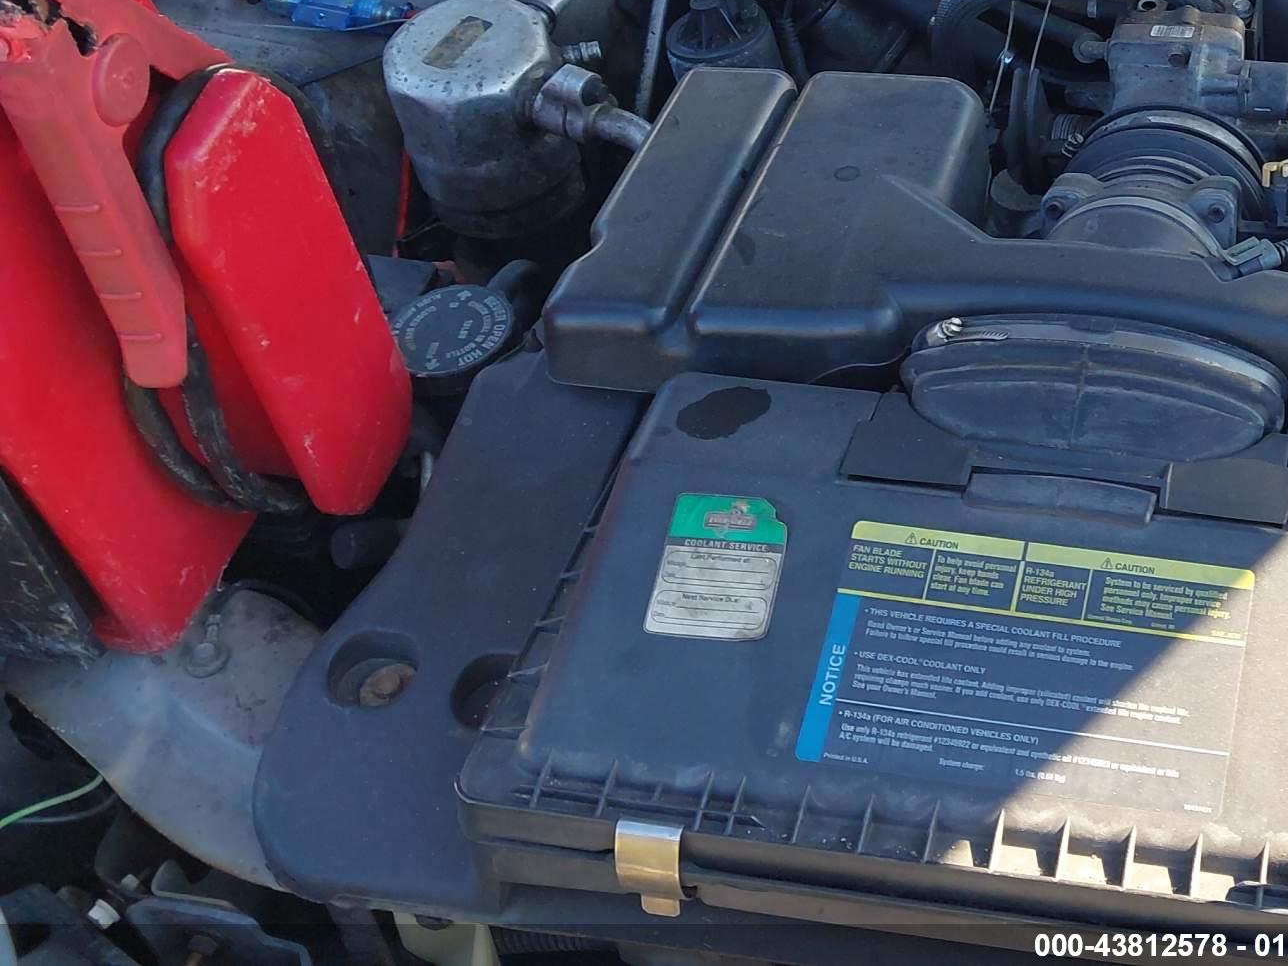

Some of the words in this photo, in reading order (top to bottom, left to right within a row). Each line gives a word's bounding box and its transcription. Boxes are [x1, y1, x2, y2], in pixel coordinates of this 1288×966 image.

[484, 296, 507, 321] NEVER
[481, 324, 506, 349] OPEN
[458, 349, 483, 366] HOT
[684, 538, 729, 550] COOLANT
[729, 541, 768, 552] SERVICE
[852, 544, 871, 553] FAN
[872, 547, 903, 557] BLADE
[918, 537, 959, 549] CAUTION
[850, 553, 886, 564] STARTS
[886, 557, 927, 569] WITHOUT
[937, 555, 946, 563] To
[946, 556, 962, 566] help
[963, 559, 984, 568] avoid
[984, 561, 1017, 573] personal
[1114, 562, 1155, 574] CAUTION
[847, 561, 883, 573] ENGINE
[883, 566, 925, 578] RUNNING
[957, 567, 976, 577] keep
[976, 570, 1000, 579] hands
[1025, 567, 1054, 577] R-134a
[930, 581, 947, 590] start
[956, 586, 970, 594] any
[953, 575, 968, 584] Fan
[968, 577, 989, 587] blade
[1023, 575, 1087, 590] REFRIGERANT
[1105, 576, 1132, 587] System
[1153, 583, 1184, 593] serviced
[1184, 587, 1193, 596] by
[1021, 584, 1052, 594] UNDER
[1054, 588, 1077, 598] HIGH
[1020, 593, 1068, 606] PRESSURE
[1101, 595, 1133, 605] methods
[1134, 600, 1150, 609] may
[1151, 602, 1173, 611] cause
[1174, 604, 1207, 616] personal
[1158, 593, 1193, 605] Improper
[1194, 598, 1221, 607] service
[1100, 604, 1115, 612] See
[1115, 605, 1144, 616] Service
[869, 608, 888, 617] THIS
[889, 611, 923, 621] VEHICLE
[923, 615, 967, 627] REQUIRES
[975, 622, 1010, 633] SPECIAL
[1010, 627, 1050, 638] COOLANT
[1051, 632, 1069, 641] FILL
[1070, 635, 1121, 648] PROCEDURE
[867, 620, 885, 629] Read
[920, 627, 946, 637] Service
[946, 631, 972, 640] Manual
[972, 634, 994, 643] before
[995, 637, 1018, 647] adding
[1031, 642, 1056, 652] coolant
[1057, 645, 1064, 653] to
[865, 628, 889, 637] Failure
[897, 632, 918, 641] follow
[918, 635, 944, 646] special
[953, 641, 987, 652] procedure
[988, 644, 1007, 653] could
[1007, 647, 1027, 656] result
[1036, 651, 1061, 660] serious
[1061, 654, 1088, 665] damage
[1097, 659, 1108, 667] the
[858, 650, 876, 659] USE
[922, 659, 963, 671] COOLANT
[962, 664, 986, 674] ONLY
[819, 643, 846, 706] NOTICE
[851, 680, 865, 688] See
[866, 683, 881, 692] your
[856, 664, 871, 672] This
[871, 666, 896, 675] vehicle
[910, 671, 940, 681] extended
[981, 681, 1004, 692] Adding
[1005, 685, 1036, 696] improper
[1071, 694, 1097, 703] coolant
[884, 677, 909, 688] change
[1029, 697, 1045, 706] only
[1086, 704, 1116, 715] extended
[843, 710, 871, 720] R-134a
[872, 714, 893, 723] (FOR
[894, 717, 909, 725] AIR
[910, 719, 969, 734] CONDITIONED
[969, 728, 1012, 740] VEHICLES
[1012, 733, 1039, 744] ONLY)
[838, 731, 851, 740] A/C
[851, 734, 876, 744] system
[876, 737, 890, 745] will
[840, 723, 855, 731] Use
[854, 725, 870, 735] only
[870, 727, 896, 737] R-134a
[895, 730, 932, 743] refrigerant
[979, 742, 1015, 755] equivalent
[1015, 748, 1029, 756] and
[823, 751, 844, 760] Printed
[937, 757, 961, 767] System
